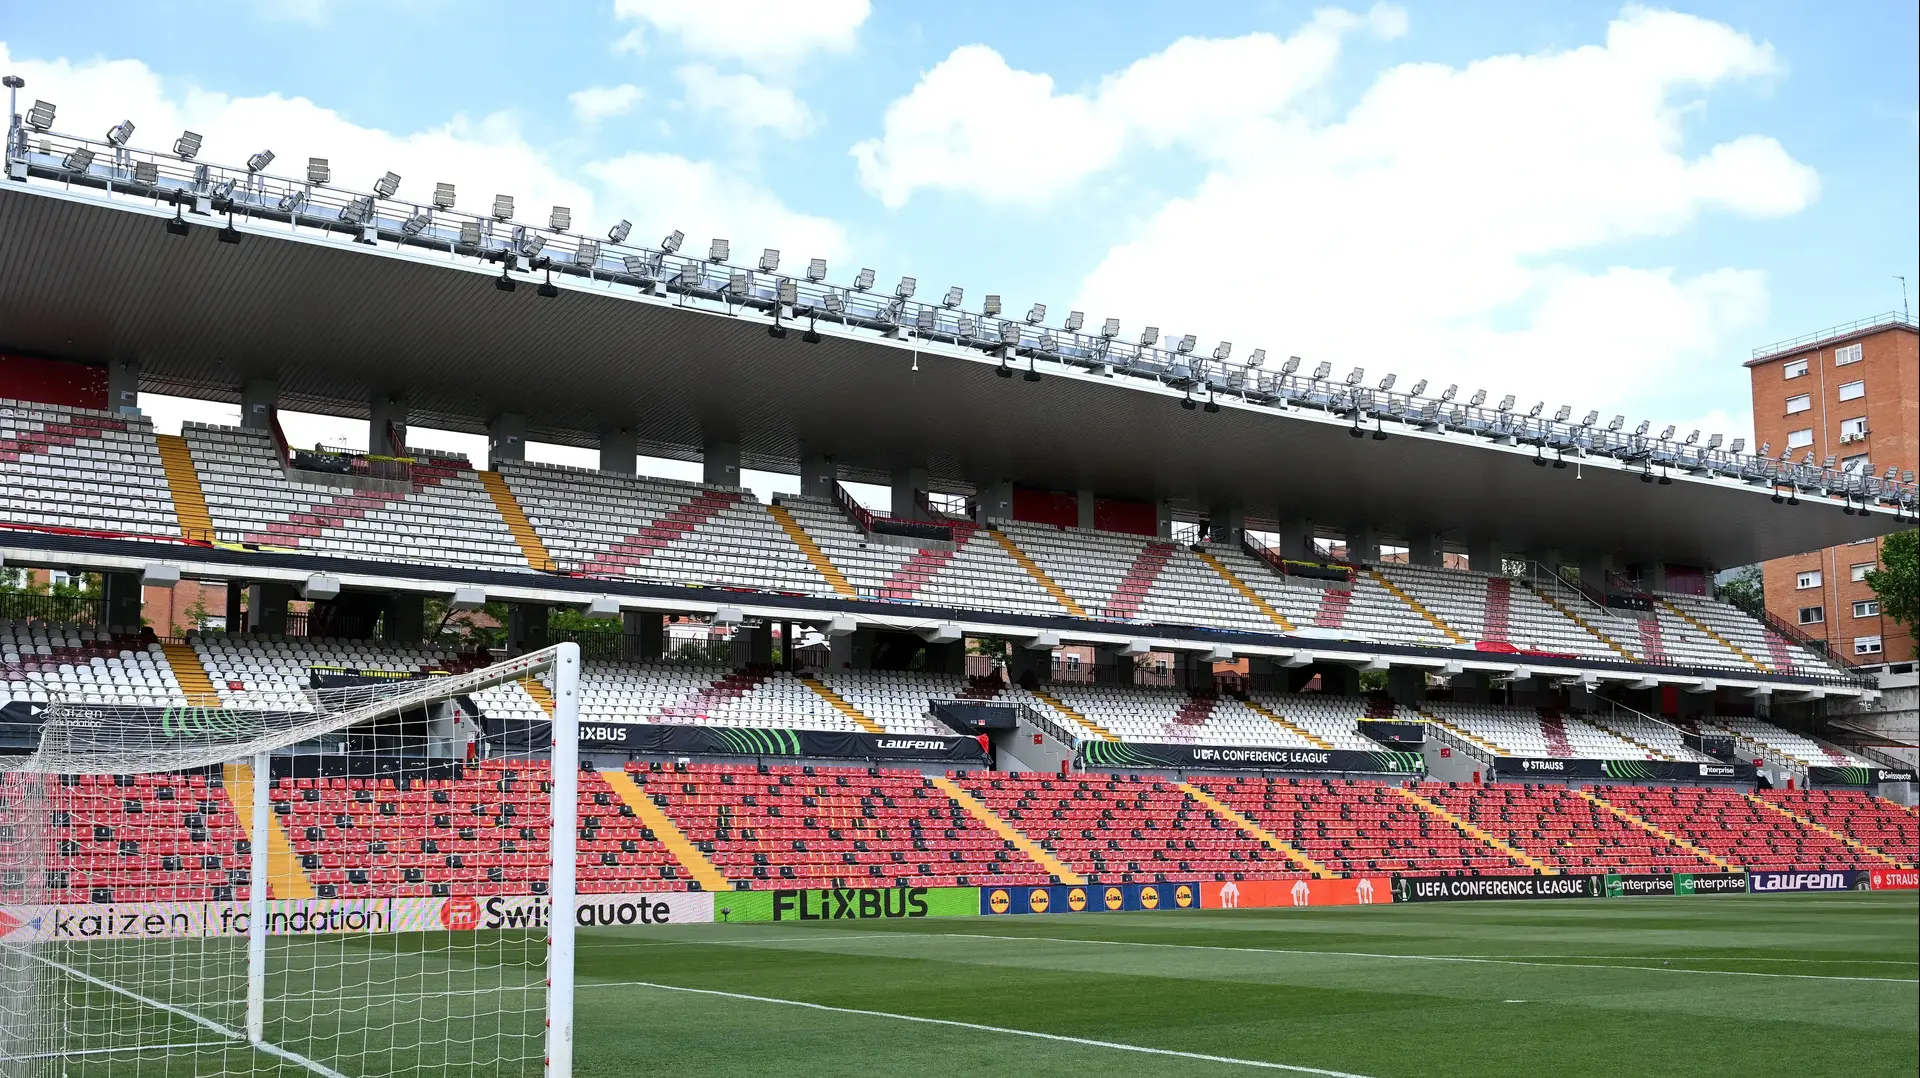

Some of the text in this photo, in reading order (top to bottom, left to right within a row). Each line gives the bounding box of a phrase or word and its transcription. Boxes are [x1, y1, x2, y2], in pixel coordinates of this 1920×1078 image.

[52, 719, 101, 727] oundation
[578, 726, 627, 741] iXBUS
[1222, 750, 1287, 762] CONFERENCE
[1290, 753, 1328, 763] LEAGUE
[1531, 761, 1564, 770] STRAUSS
[1885, 771, 1911, 781] Swissquote
[1608, 878, 1673, 892] enterprise
[1681, 877, 1745, 891] enterprise
[1886, 874, 1919, 885] STRAUS
[1416, 879, 1583, 896] UEFA CONFERENCE LEAGUE
[486, 897, 670, 929] Swiquote
[55, 908, 188, 936] kaizen
